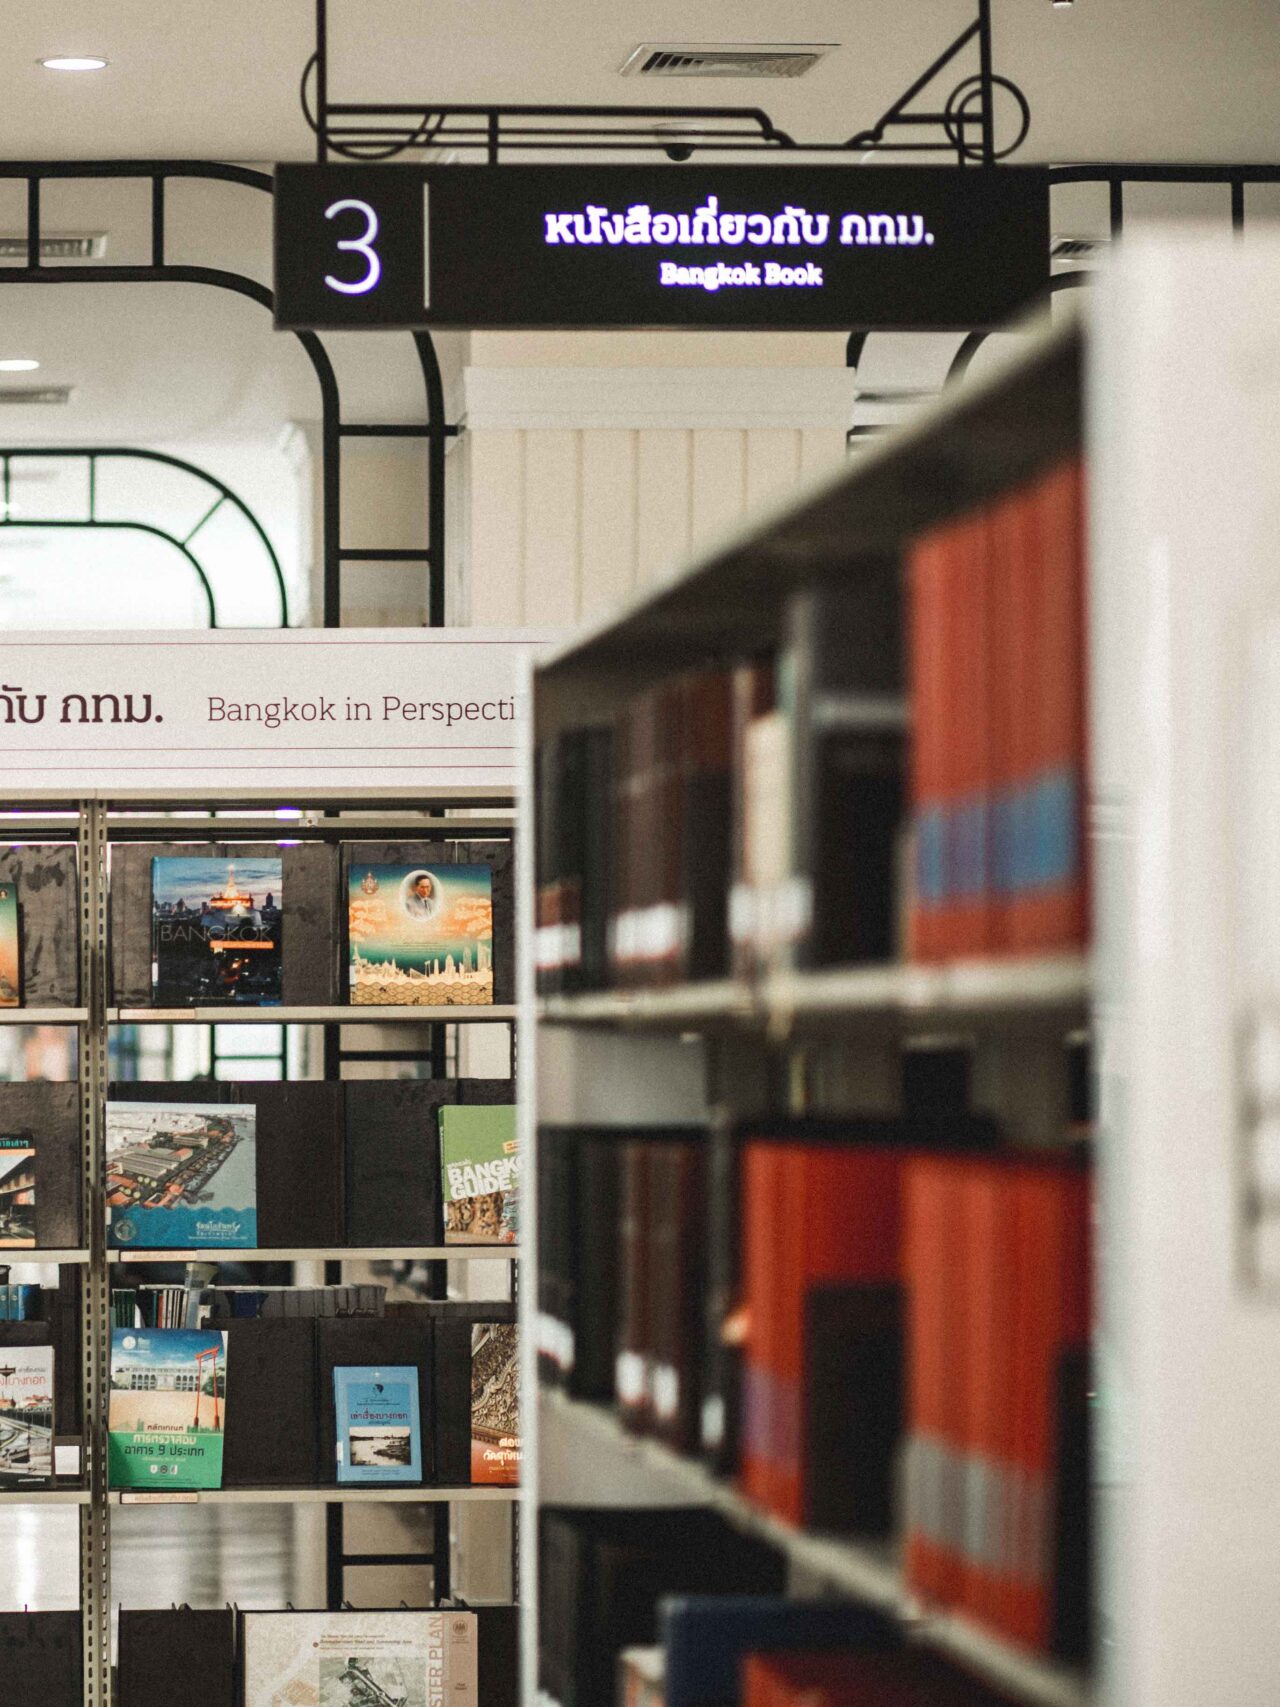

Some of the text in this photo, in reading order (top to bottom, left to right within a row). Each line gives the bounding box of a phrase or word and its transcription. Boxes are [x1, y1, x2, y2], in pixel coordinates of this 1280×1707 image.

[543, 196, 936, 247] หนังสือเกี่ยวกับ กทม.
[323, 198, 382, 295] 3
[659, 261, 824, 291] Bangkok Book
[59, 692, 164, 725] กทม.
[207, 696, 516, 728] Bangkok in Perspecti
[160, 925, 272, 942] BANGKOK
[450, 1174, 513, 1200] GUIDE
[158, 1445, 166, 1456] 9
[428, 1617, 444, 1661] PLAN
